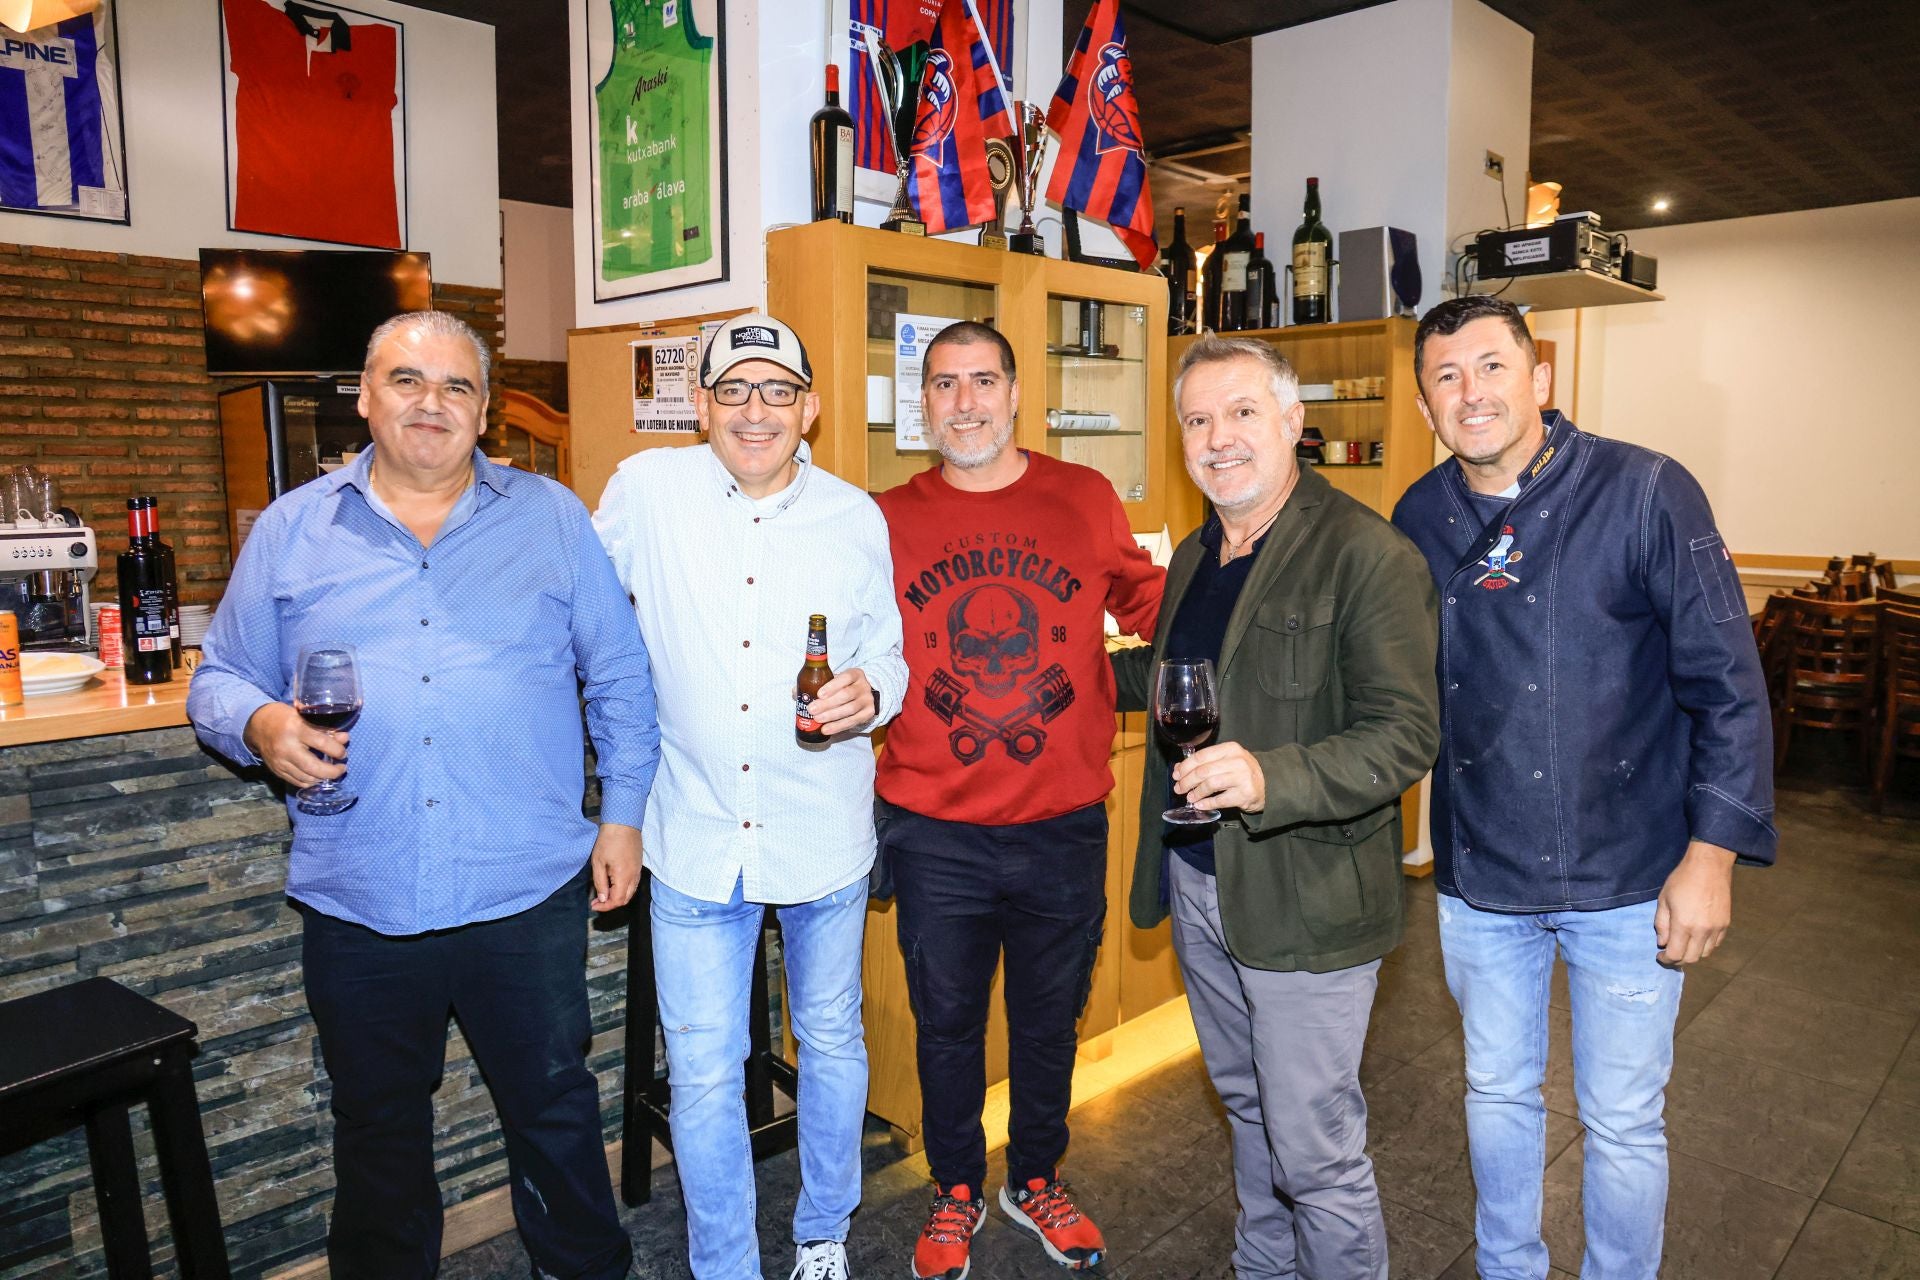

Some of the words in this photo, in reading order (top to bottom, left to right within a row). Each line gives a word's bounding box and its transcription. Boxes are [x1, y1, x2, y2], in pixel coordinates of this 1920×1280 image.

[920, 7, 937, 18] COPA
[631, 66, 669, 106] Araski
[626, 133, 677, 164] kutxabank
[623, 190, 649, 209] araba
[656, 180, 685, 200] álava
[655, 347, 685, 365] 62720
[635, 419, 646, 430] HAY
[646, 419, 667, 430] LOTERIA
[668, 419, 675, 430] DE
[676, 419, 700, 431] NAVIDAD
[943, 532, 1037, 554] CUSTOM
[904, 547, 1082, 613] MOTORCYCLES
[924, 631, 937, 649] 19
[1051, 625, 1067, 643] 98
